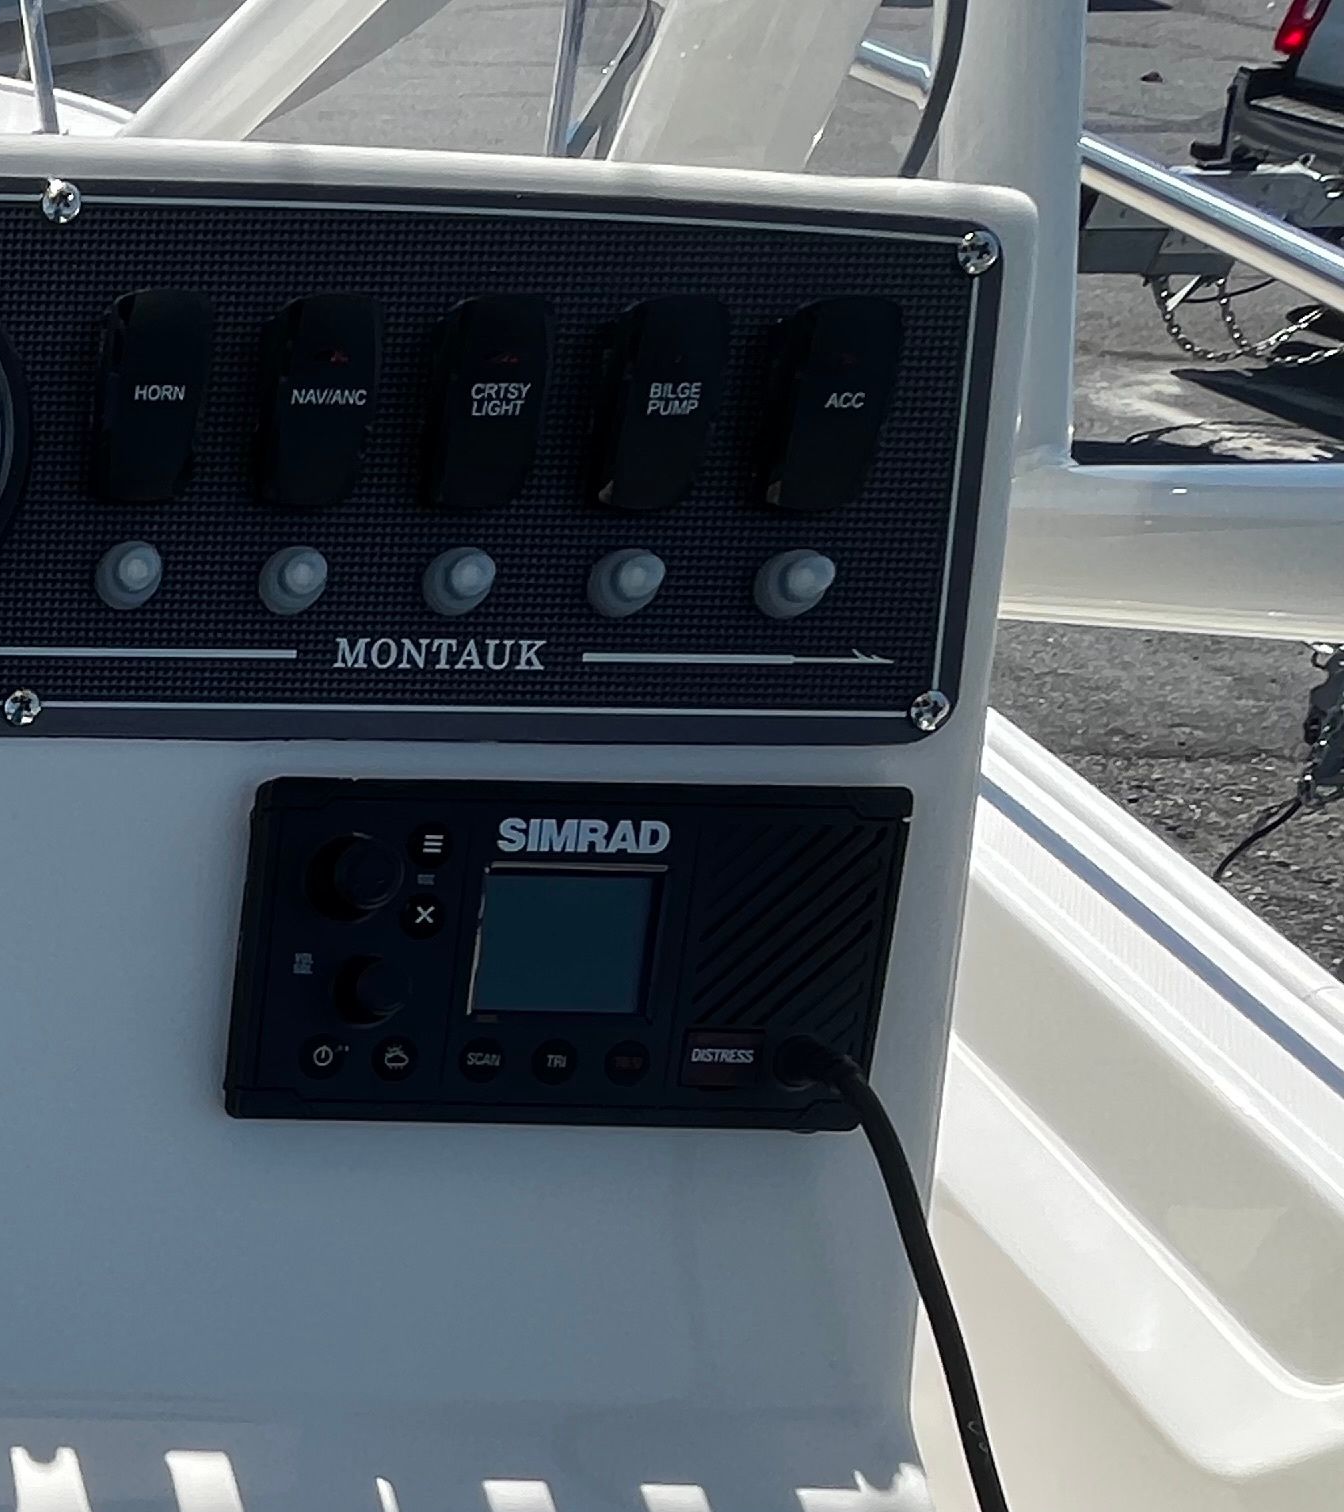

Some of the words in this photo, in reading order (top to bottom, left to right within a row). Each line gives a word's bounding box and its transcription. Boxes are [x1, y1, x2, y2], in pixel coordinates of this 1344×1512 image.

[134, 384, 186, 401] HORN
[291, 388, 367, 406] NAV/ANC
[471, 383, 531, 401] CRTSY
[650, 382, 702, 400] BILGE
[472, 400, 524, 417] LIGHT
[647, 400, 699, 416] PUMP
[825, 392, 866, 409] ACC
[333, 637, 547, 671] MONTAUK
[497, 818, 671, 854] SIMRAD
[466, 1052, 500, 1067] SCAN
[690, 1048, 755, 1063] DISTRESS
